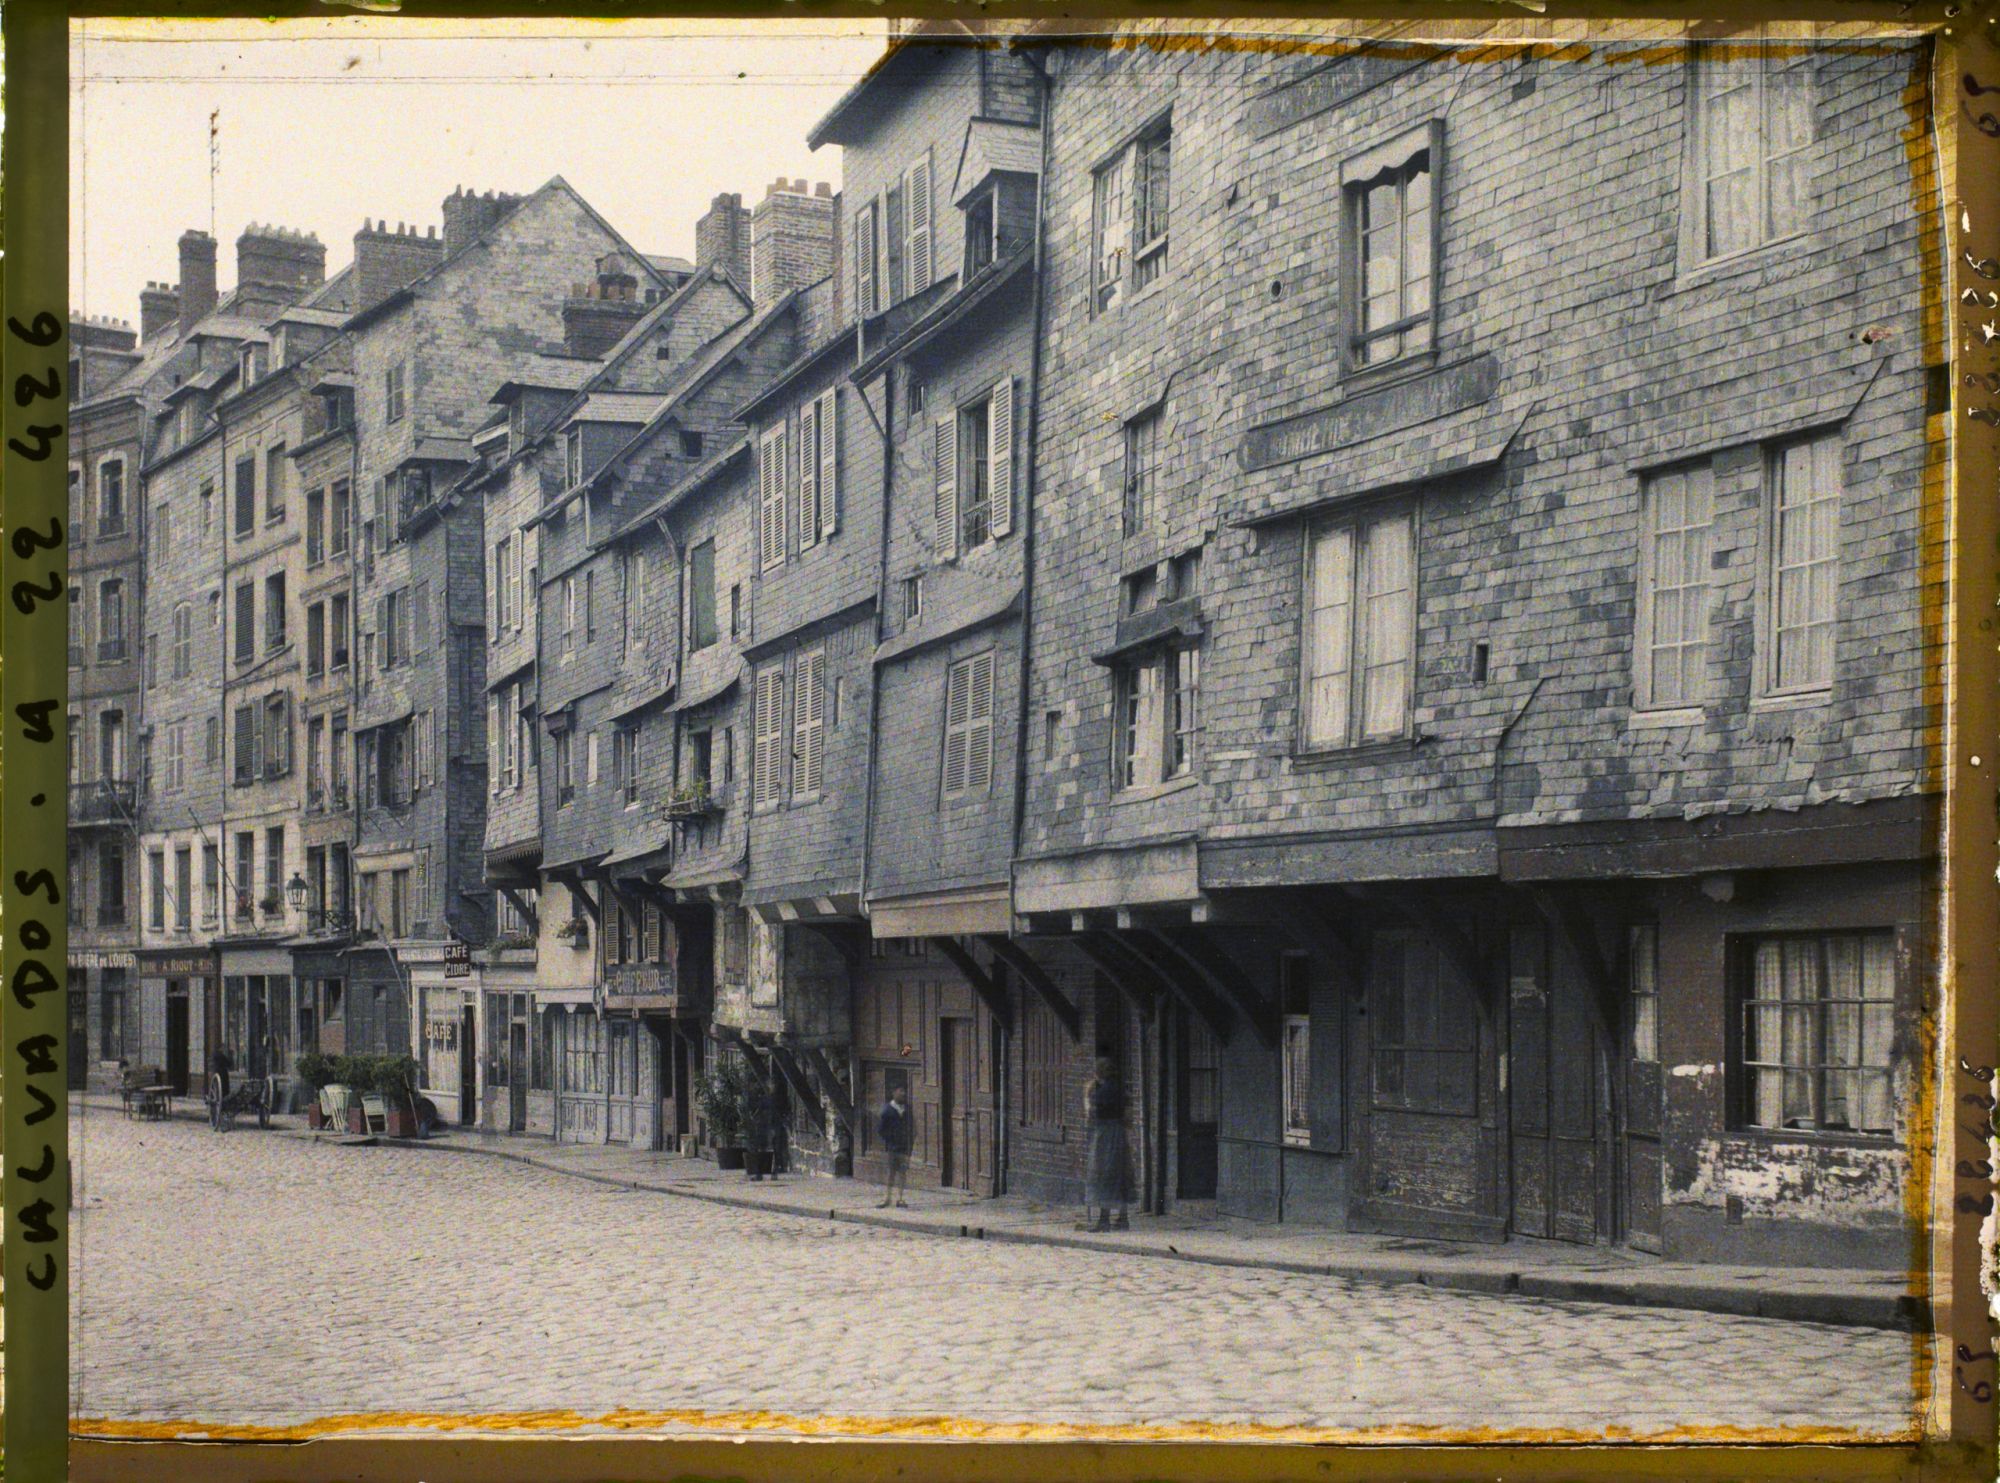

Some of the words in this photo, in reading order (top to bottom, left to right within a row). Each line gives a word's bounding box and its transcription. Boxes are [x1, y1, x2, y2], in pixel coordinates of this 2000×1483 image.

[8, 311, 63, 461] 426
[11, 517, 63, 615] 22
[15, 699, 60, 743] A
[445, 945, 467, 961] CAFÉ
[445, 962, 470, 976] CIDRE
[12, 868, 60, 1290] CALVADOS
